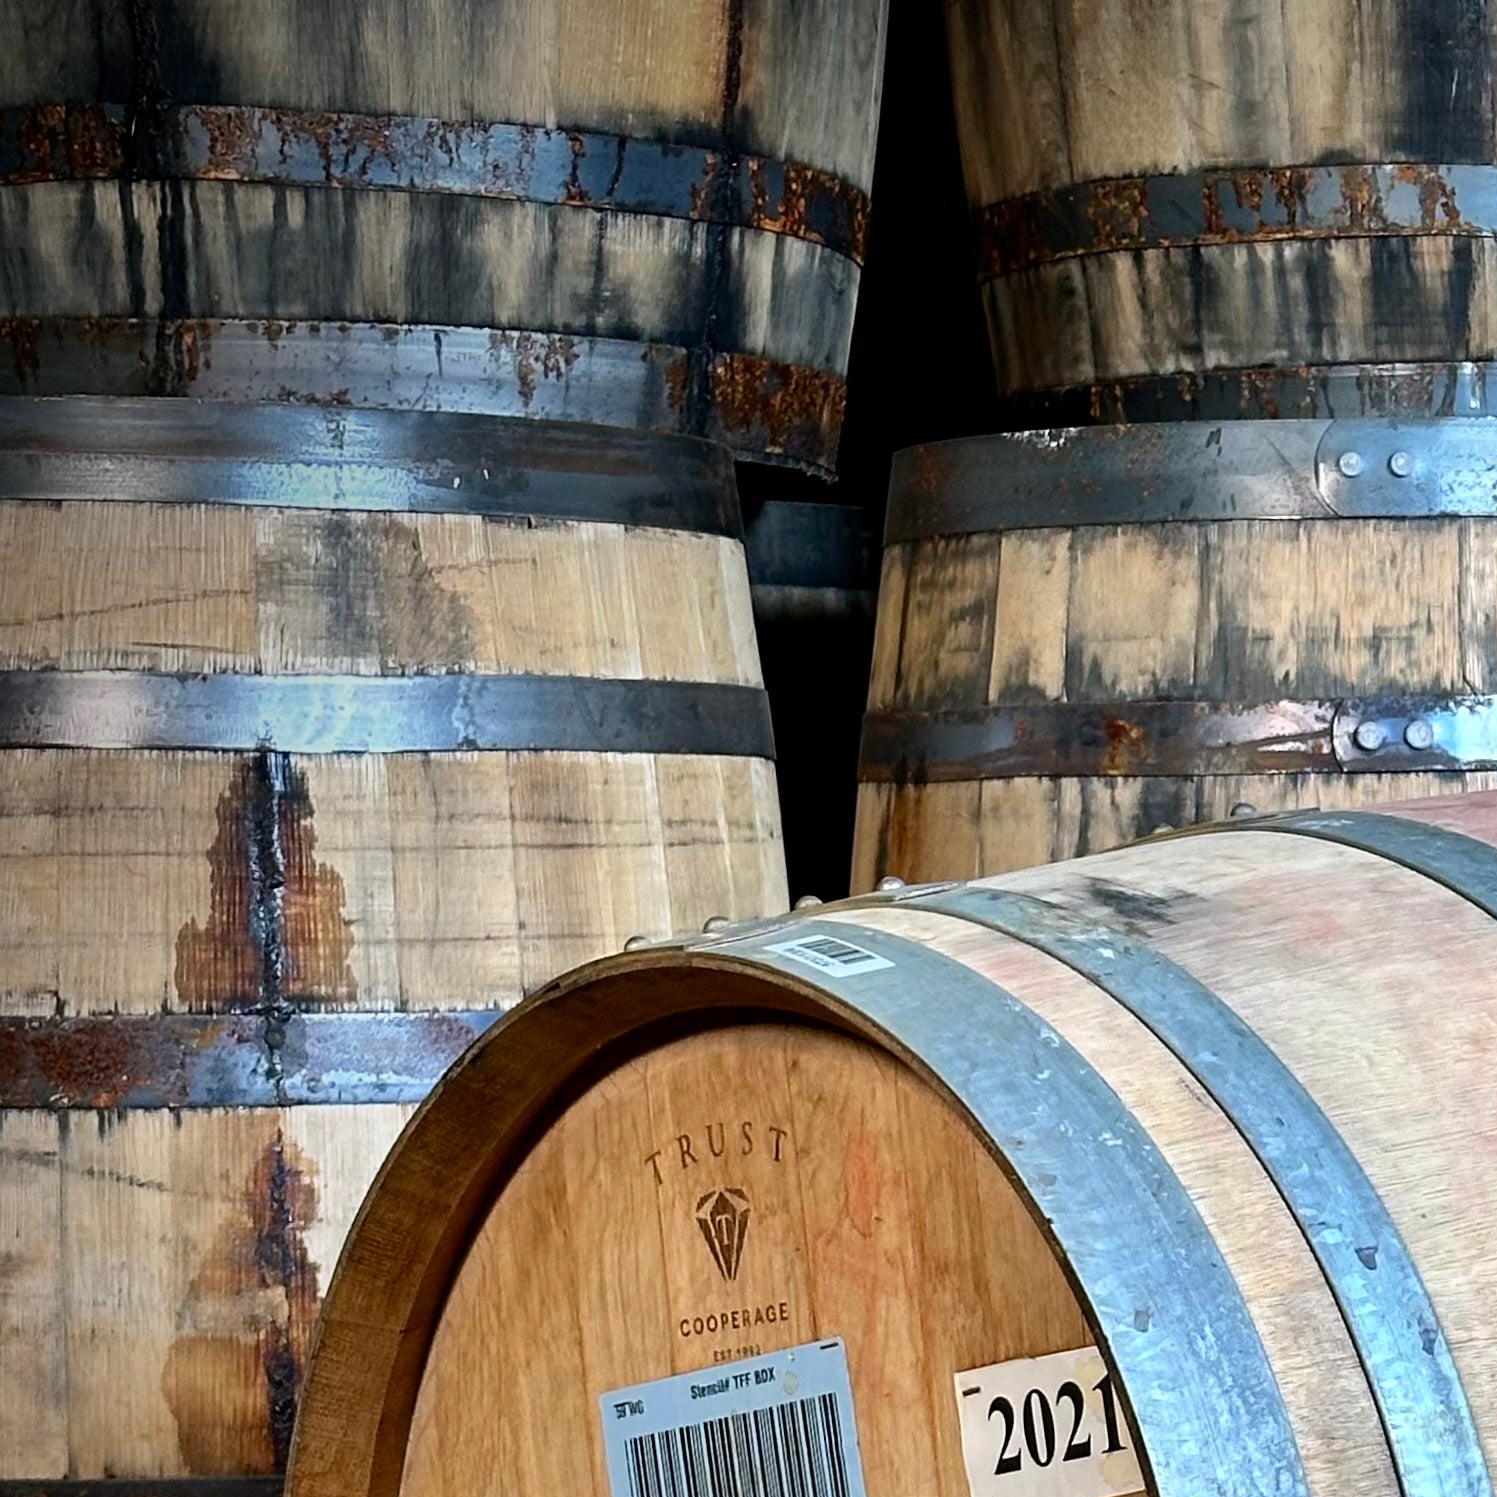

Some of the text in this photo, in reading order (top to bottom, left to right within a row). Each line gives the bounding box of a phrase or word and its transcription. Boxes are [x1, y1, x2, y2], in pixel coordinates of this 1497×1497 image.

[645, 1121, 787, 1184] TRUST
[680, 1302, 789, 1337] COOPERAGE
[732, 1372, 751, 1389] TFF
[987, 1371, 1128, 1475] 2021
